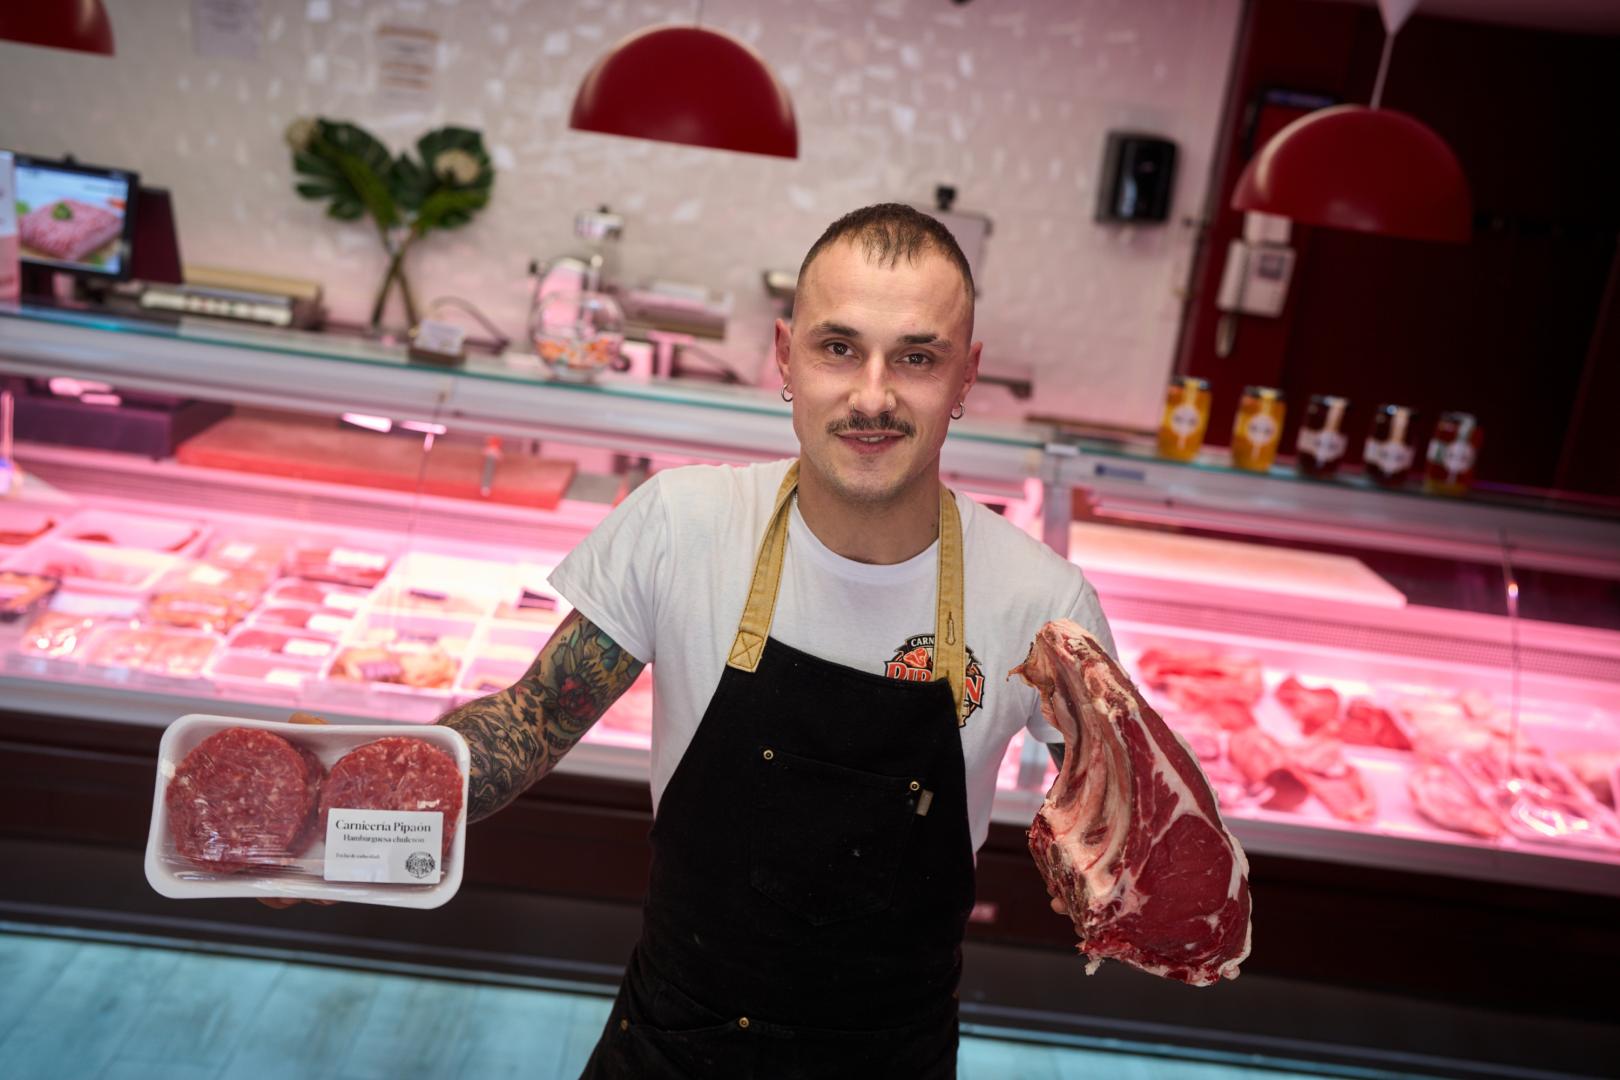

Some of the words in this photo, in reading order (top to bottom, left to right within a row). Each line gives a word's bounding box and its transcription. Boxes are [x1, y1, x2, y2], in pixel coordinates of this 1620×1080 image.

[911, 637, 936, 647] CARN
[394, 822, 431, 834] Pipaón
[343, 834, 391, 843] Hamburguesa
